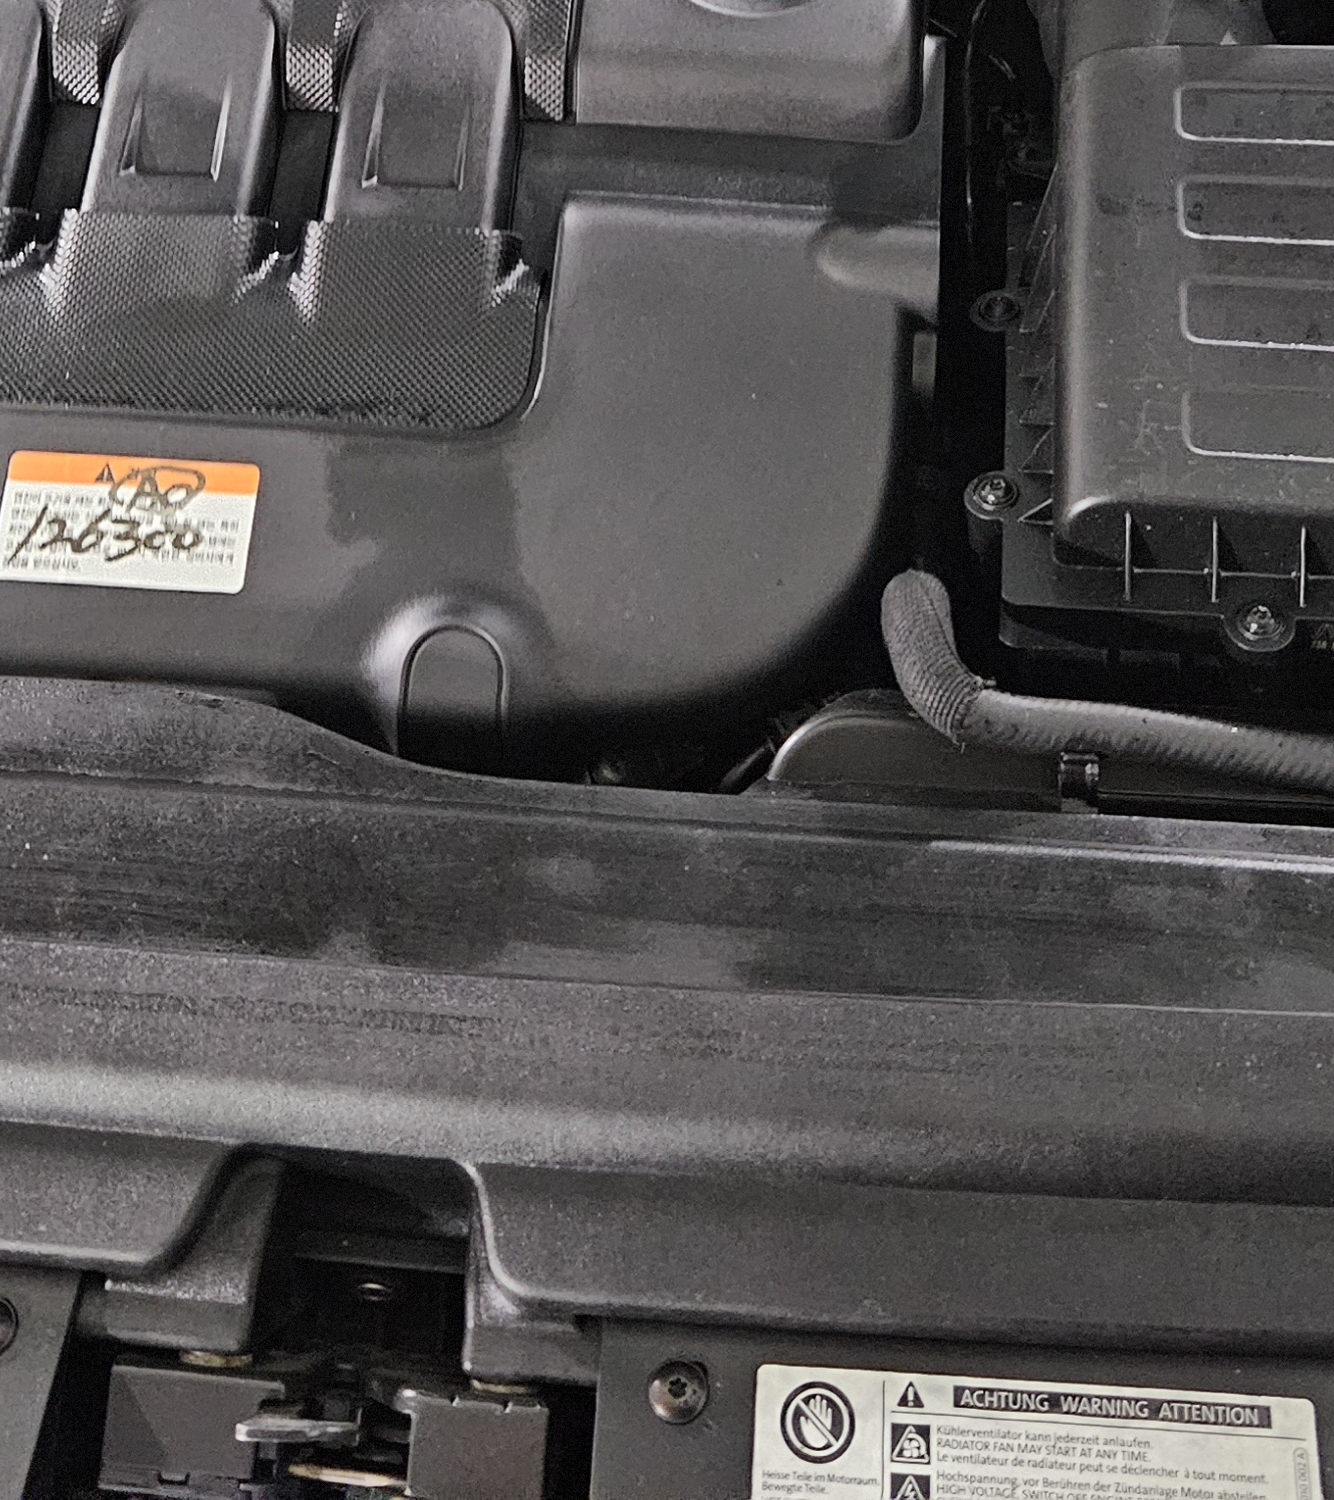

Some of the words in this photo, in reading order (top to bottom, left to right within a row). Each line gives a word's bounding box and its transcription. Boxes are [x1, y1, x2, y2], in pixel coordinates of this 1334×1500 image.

[960, 1389, 1050, 1412] ACHTUNG
[1060, 1395, 1149, 1418] WARNING
[1158, 1402, 1260, 1426] ATTENTION
[936, 1424, 1023, 1441] Kühlerventilator
[1024, 1430, 1052, 1442] kann
[1053, 1432, 1100, 1446] jederzeit
[1102, 1436, 1154, 1450] anlaufen.
[936, 1437, 991, 1452] RADIATOR
[993, 1442, 1015, 1453] FAN
[1017, 1443, 1043, 1455] MAY
[1044, 1445, 1077, 1457] START
[1079, 1447, 1093, 1458] AT
[1095, 1448, 1119, 1461] ANY
[1121, 1450, 1152, 1463] TIME.
[762, 1470, 791, 1481] Heisse
[792, 1471, 813, 1482] Teile
[814, 1473, 826, 1483] im
[827, 1473, 881, 1487] Motorraum.
[936, 1450, 949, 1462] Le
[950, 1453, 1009, 1467] ventilateur
[1011, 1456, 1025, 1468] de
[1027, 1458, 1077, 1471] radiateur
[1079, 1462, 1104, 1475] peut
[1105, 1466, 1118, 1474] se
[1120, 1463, 1180, 1479] déclencher
[1192, 1470, 1216, 1481] tout
[1218, 1473, 1269, 1485] moment.
[762, 1481, 803, 1494] Bewegte
[936, 1483, 967, 1495] HIGH
[1021, 1488, 1064, 1500] SWITCH
[1022, 1477, 1040, 1487] vor
[1042, 1476, 1091, 1491] Berühren
[1092, 1481, 1112, 1492] der
[1114, 1482, 1179, 1498] Zündanlage
[1180, 1486, 1214, 1499] Motor
